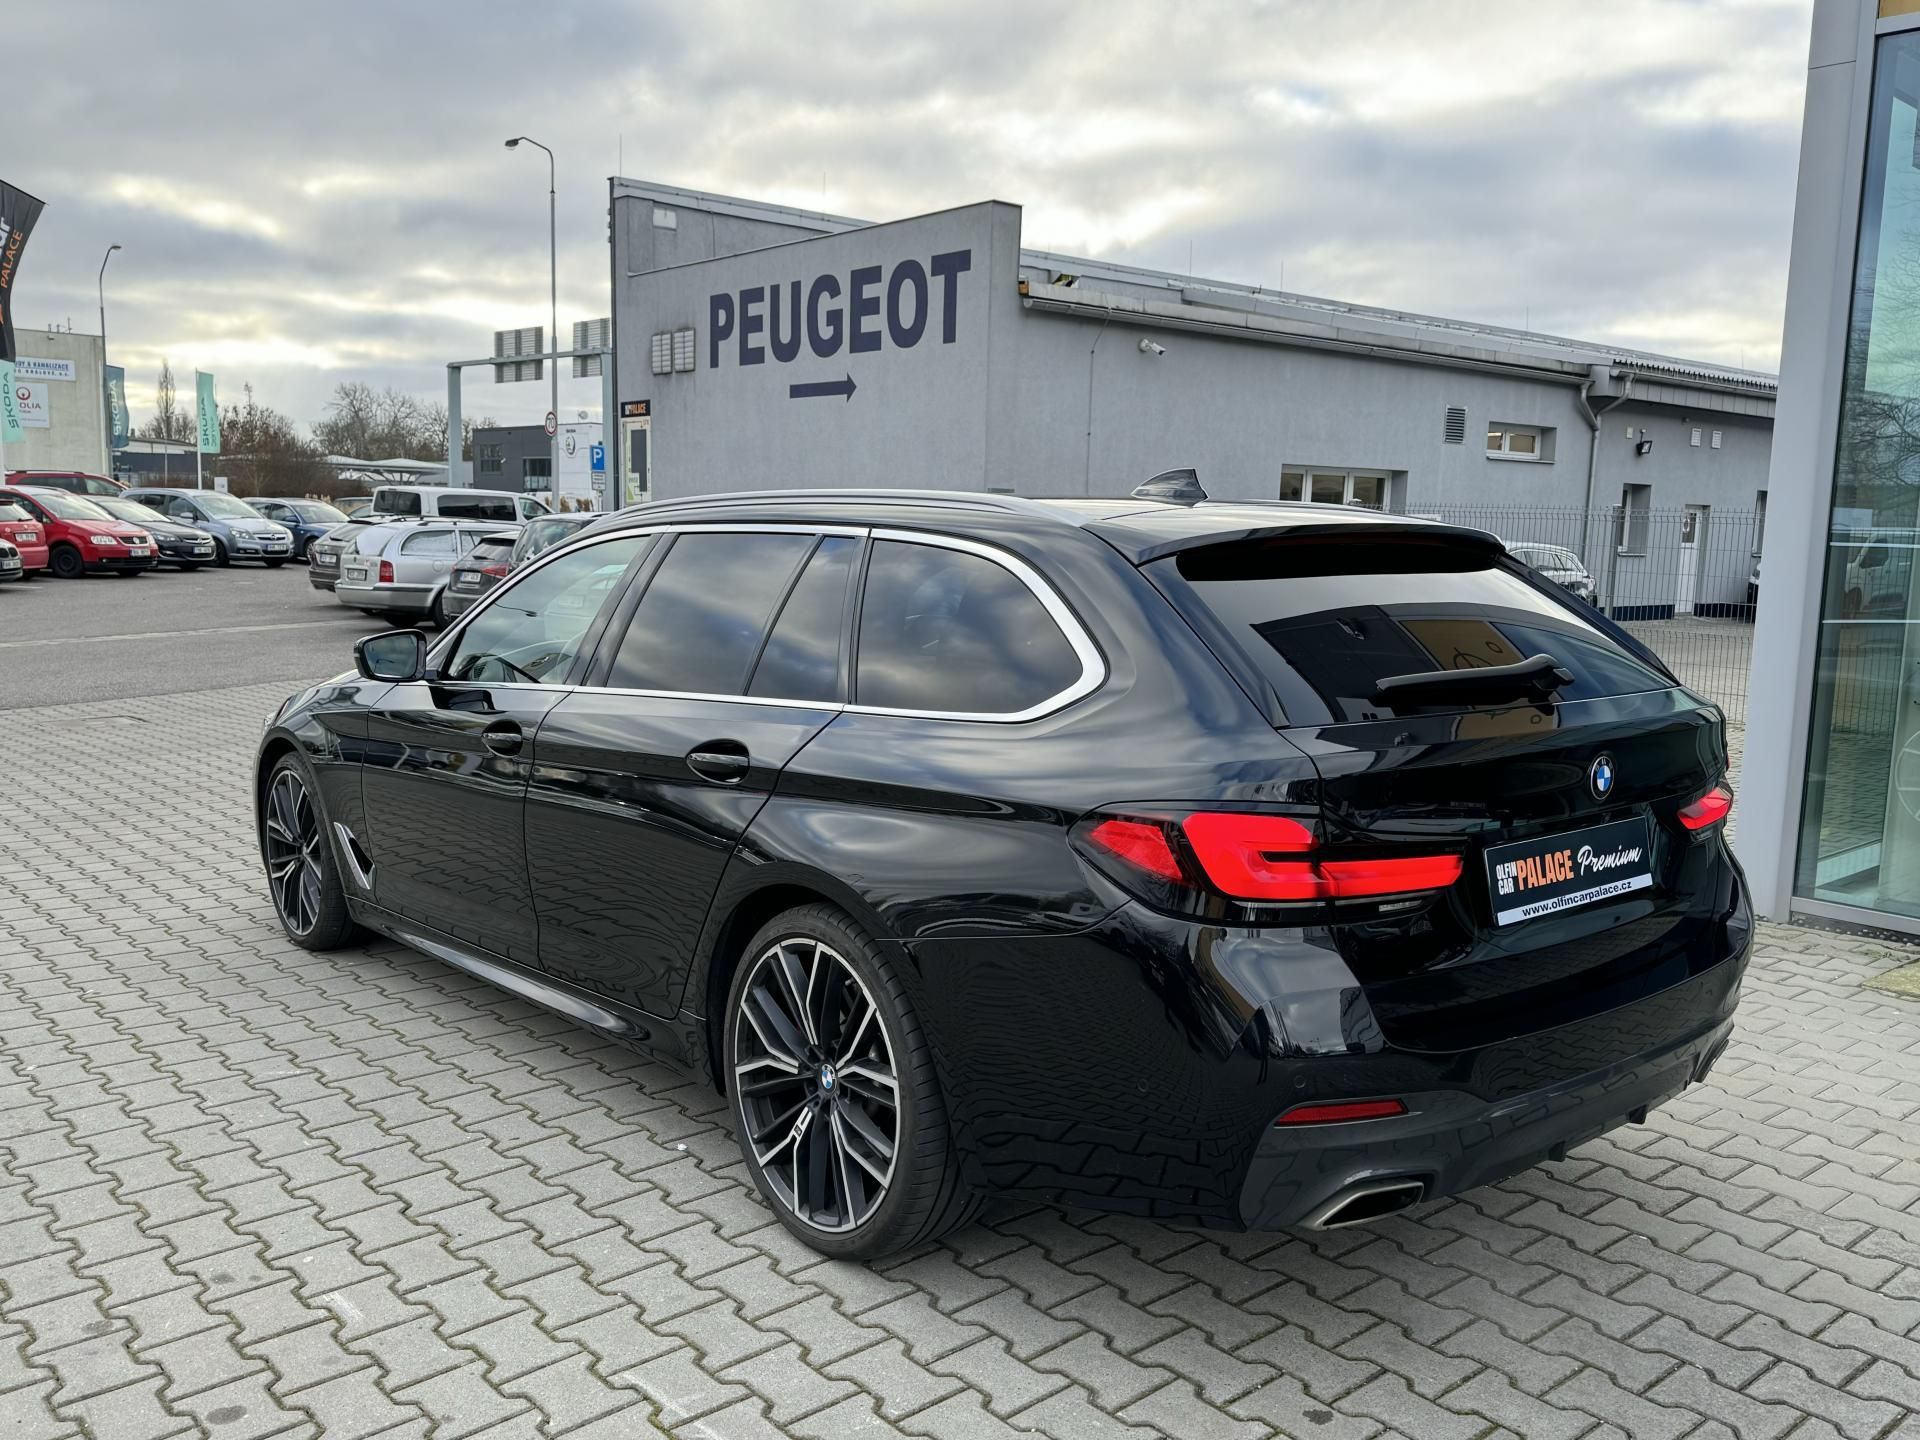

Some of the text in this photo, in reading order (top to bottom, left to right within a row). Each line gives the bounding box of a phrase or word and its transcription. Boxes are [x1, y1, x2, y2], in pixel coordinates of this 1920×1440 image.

[1, 229, 23, 289] PALACE
[709, 248, 972, 370] PEUGEOT
[593, 448, 602, 464] P
[1496, 861, 1517, 879] OLFIN
[1498, 876, 1515, 896] CAR
[1516, 844, 1643, 891] PALACE Premium
[1521, 880, 1633, 918] www.olfincarpalace.cz
